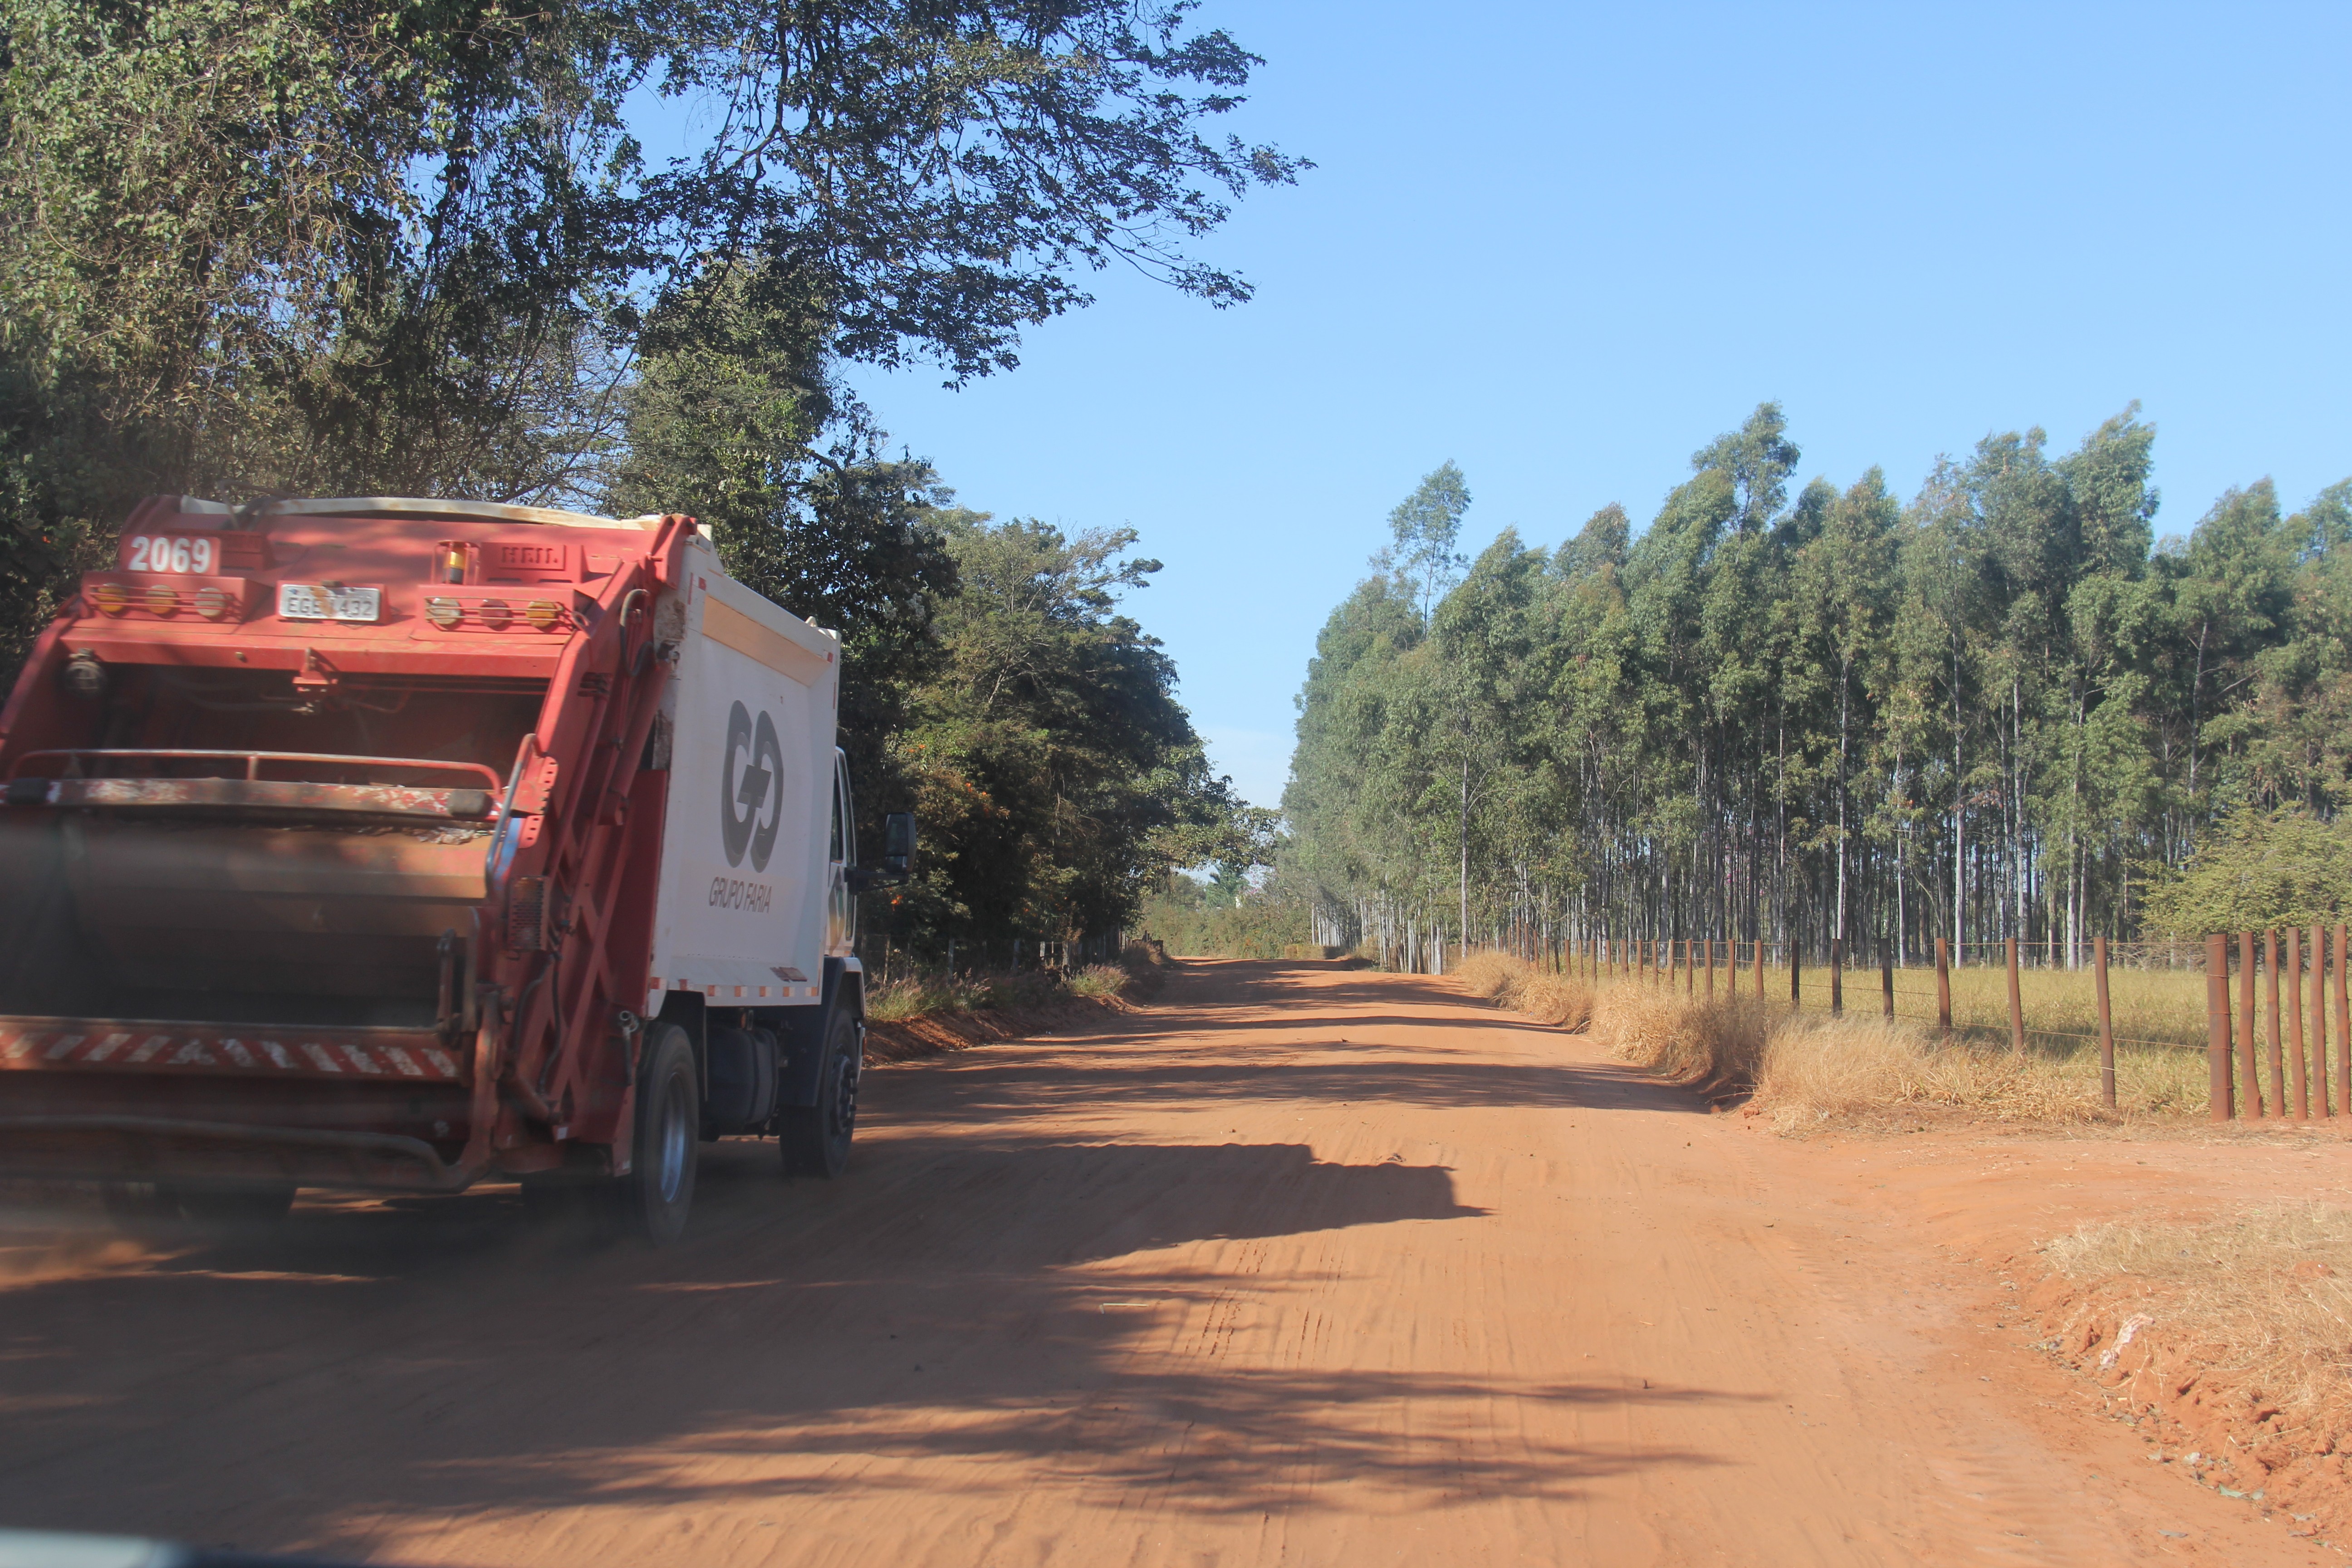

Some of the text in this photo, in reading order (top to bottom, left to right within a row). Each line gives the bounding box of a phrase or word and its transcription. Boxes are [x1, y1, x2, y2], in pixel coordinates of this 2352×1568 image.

[128, 536, 211, 573] 2069
[501, 547, 559, 564] HEIL
[709, 876, 772, 913] GRUPO FARIA
